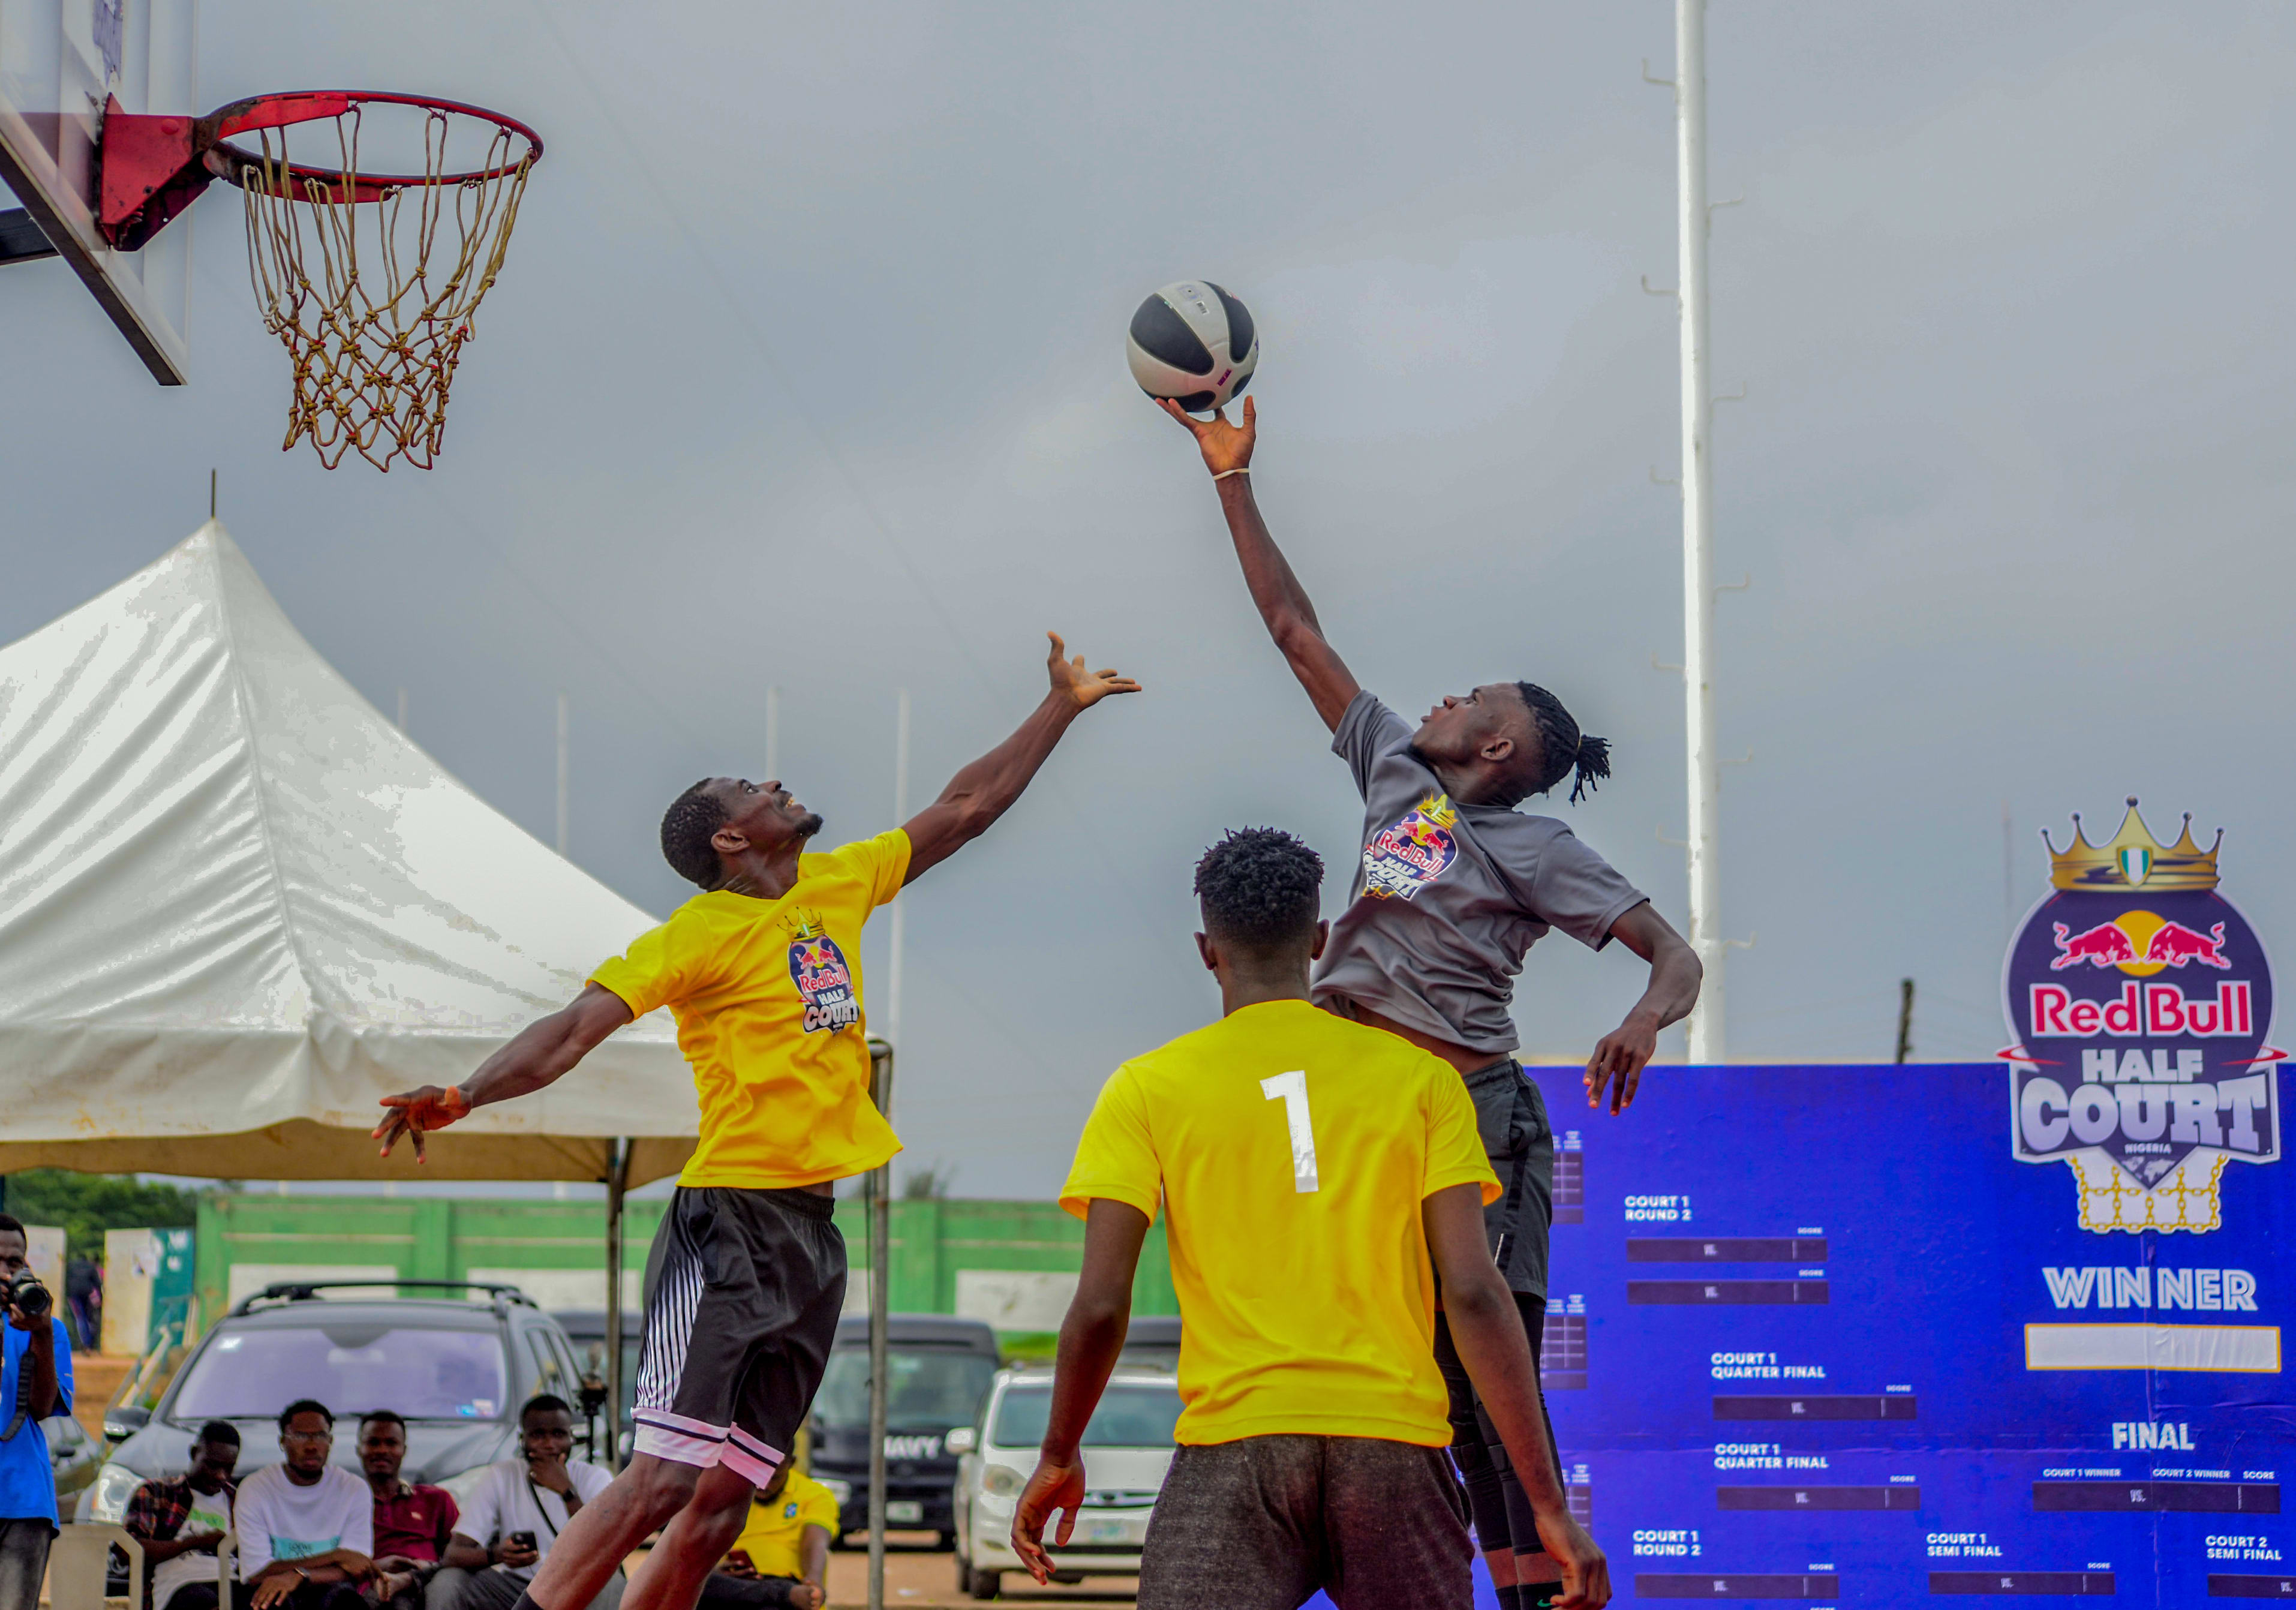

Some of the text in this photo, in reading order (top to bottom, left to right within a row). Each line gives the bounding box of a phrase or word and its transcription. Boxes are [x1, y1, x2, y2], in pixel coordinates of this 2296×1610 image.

[1379, 830, 1445, 873] Red Bull
[1382, 857, 1417, 876] HALF
[798, 964, 848, 993] Red Bull
[817, 989, 845, 1005] HALF
[804, 996, 858, 1031] COURT
[2030, 980, 2253, 1037] Red Bull
[2082, 1049, 2203, 1083] HALF
[2020, 1074, 2267, 1154] COURT
[1260, 1070, 1319, 1193] 1
[2124, 1143, 2172, 1155] NIGERIA
[1625, 1195, 1690, 1208] COURT 1
[1625, 1209, 1692, 1221] ROUND 2
[2042, 1266, 2258, 1311] WINNER
[1711, 1352, 1777, 1365] COURT 1
[1711, 1366, 1826, 1380] QUARTER FINAL
[2112, 1422, 2195, 1450] FINAL
[1714, 1443, 1781, 1455] COURT 1
[1714, 1456, 1829, 1470] QUARTER FINAL
[2043, 1468, 2076, 1477] COURT
[2153, 1468, 2231, 1479] COURT 2 WINNER
[2243, 1471, 2275, 1480] SCORE
[1633, 1530, 1699, 1542] COURT 1
[1927, 1533, 1987, 1545] COURT 1
[2205, 1535, 2268, 1548] COURT 2
[1633, 1544, 1702, 1557] ROUND 2
[1927, 1545, 2003, 1557] SEMI FINAL
[2207, 1548, 2283, 1561] SEMI FINAL
